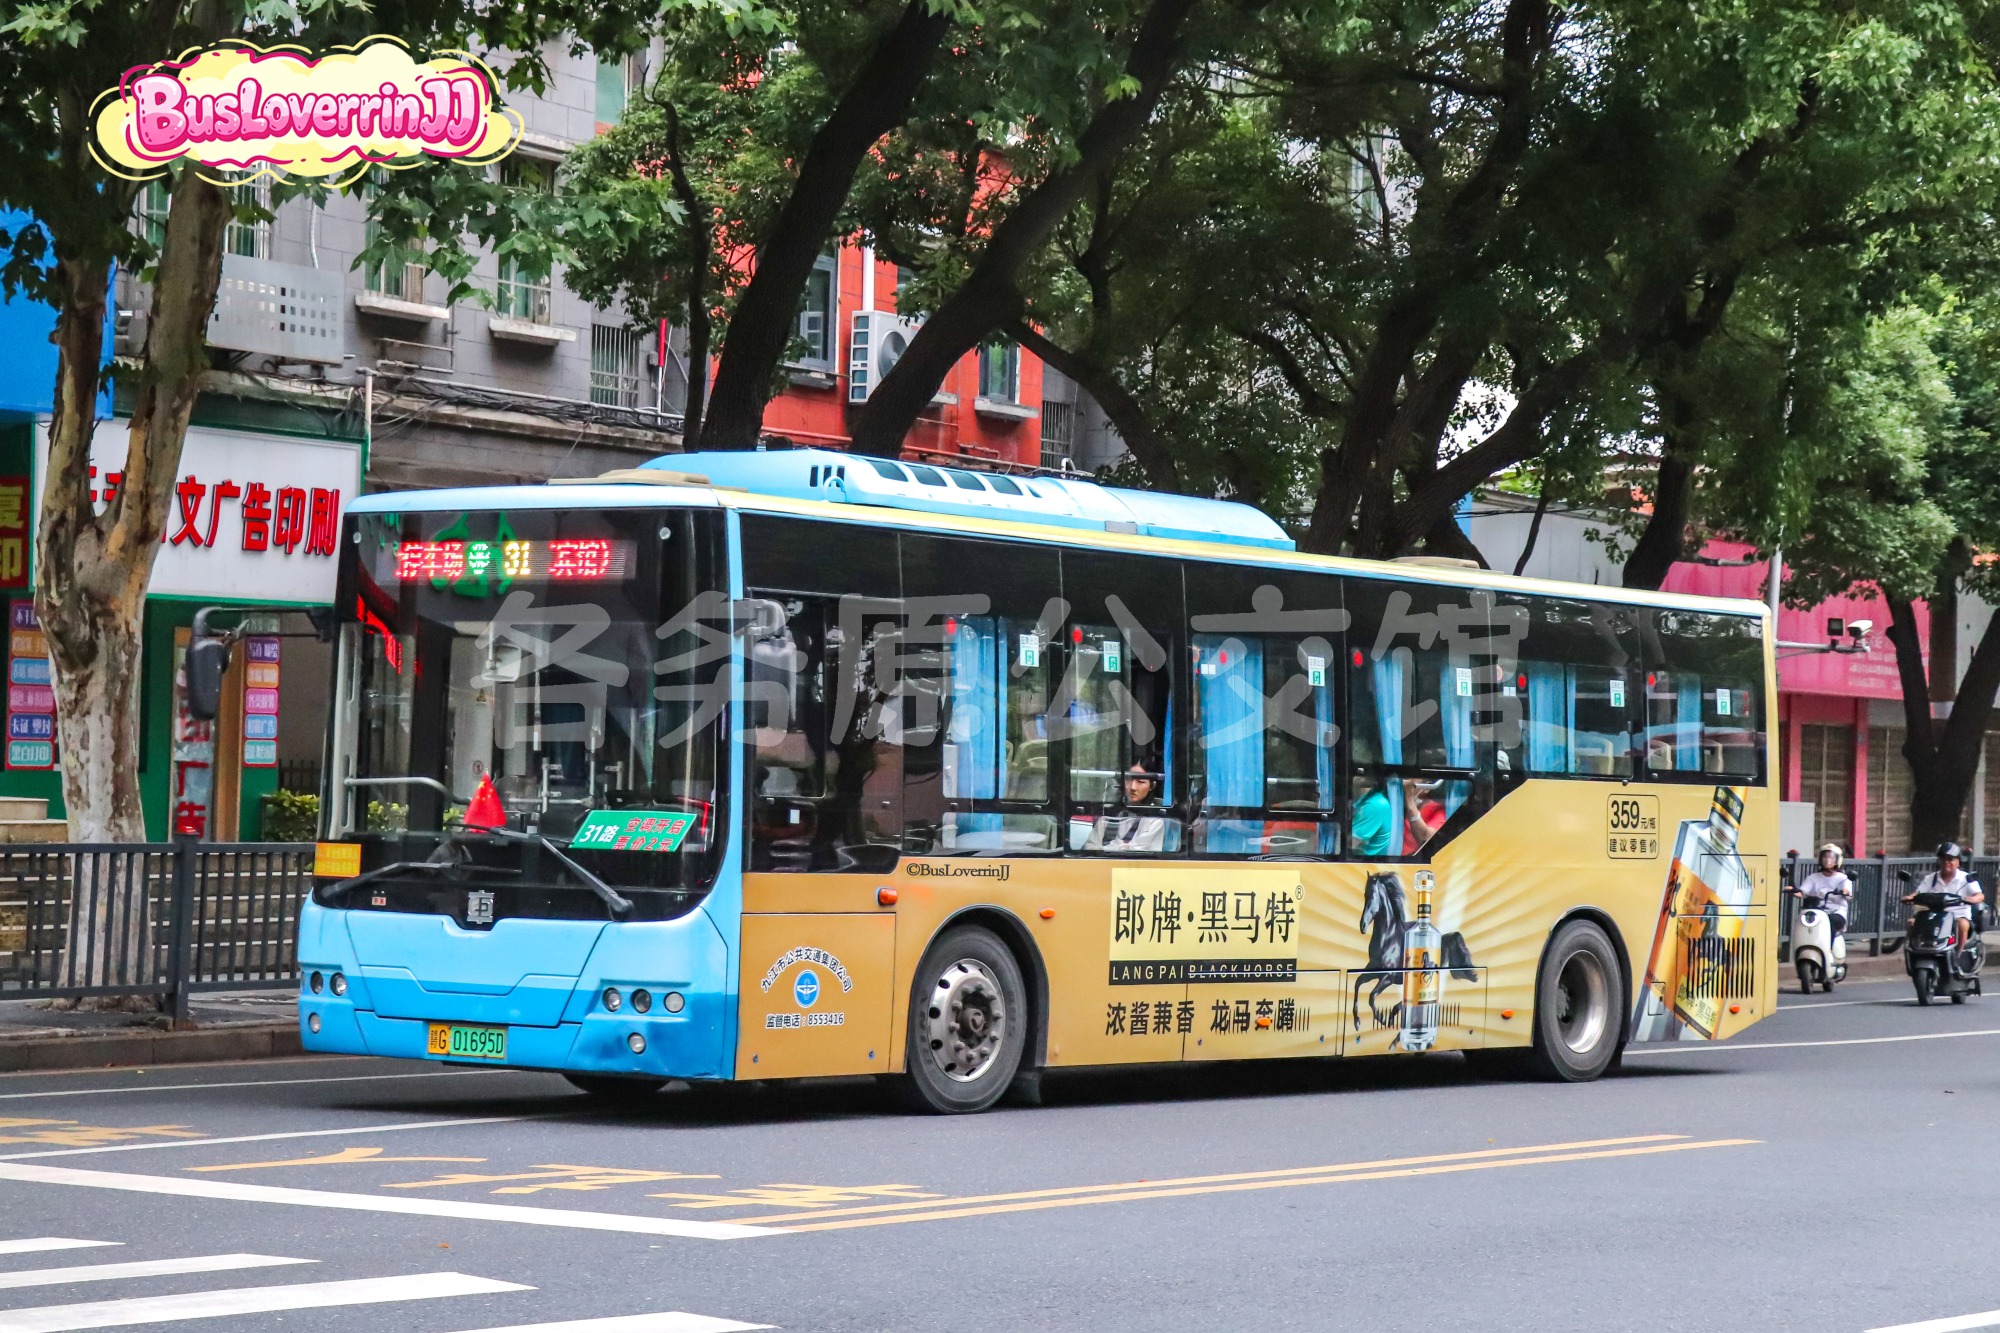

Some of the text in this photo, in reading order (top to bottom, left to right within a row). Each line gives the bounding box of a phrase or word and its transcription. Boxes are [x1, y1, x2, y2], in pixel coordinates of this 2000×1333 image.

[579, 825, 619, 843] 31路
[624, 818, 686, 834] 空调开启
[611, 836, 673, 852] 票价2元
[1609, 838, 1657, 853] 建议零售价
[1114, 890, 1296, 944] 郎牌·黑马特
[761, 946, 853, 993] 九江市公共交通集团公司
[1112, 963, 1294, 980] LANG PAI BLACK HORSE
[1105, 998, 1296, 1035] 浓酱兼香 龙马奔腾
